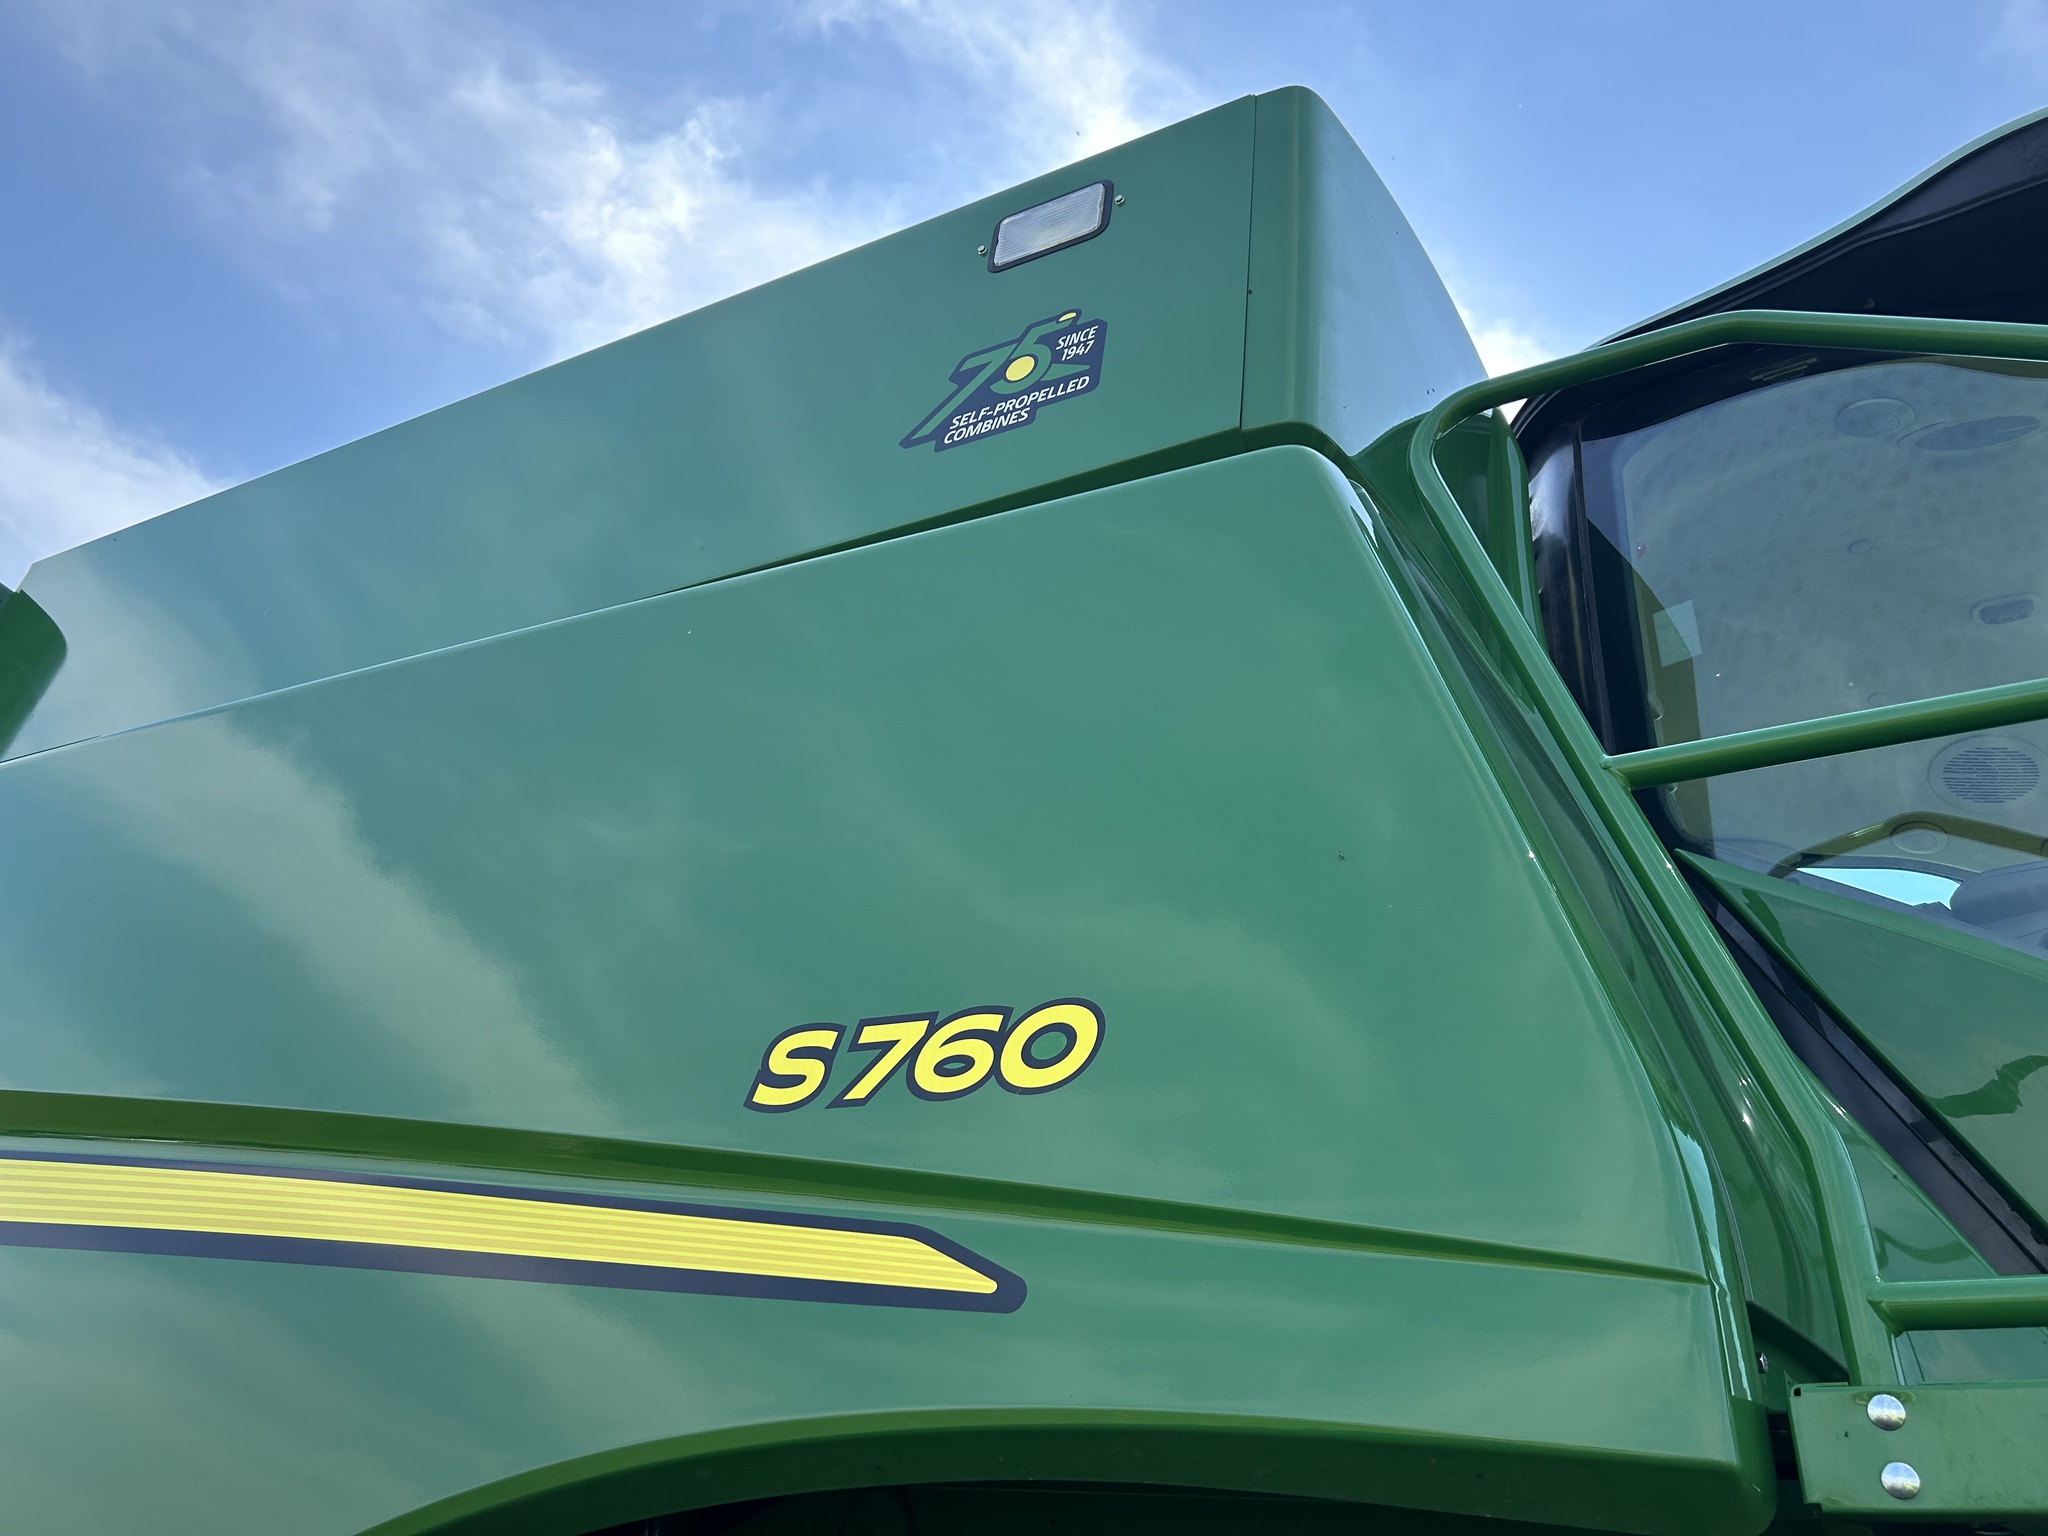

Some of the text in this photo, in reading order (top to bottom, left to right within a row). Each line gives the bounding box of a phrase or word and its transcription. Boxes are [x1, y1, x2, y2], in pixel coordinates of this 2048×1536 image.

[1056, 325, 1098, 350] SINCE
[1061, 340, 1095, 361] 1947
[950, 376, 1090, 430] SELF-PROPELLED
[944, 407, 1030, 444] COMBINES
[752, 1004, 1098, 1106] S760
